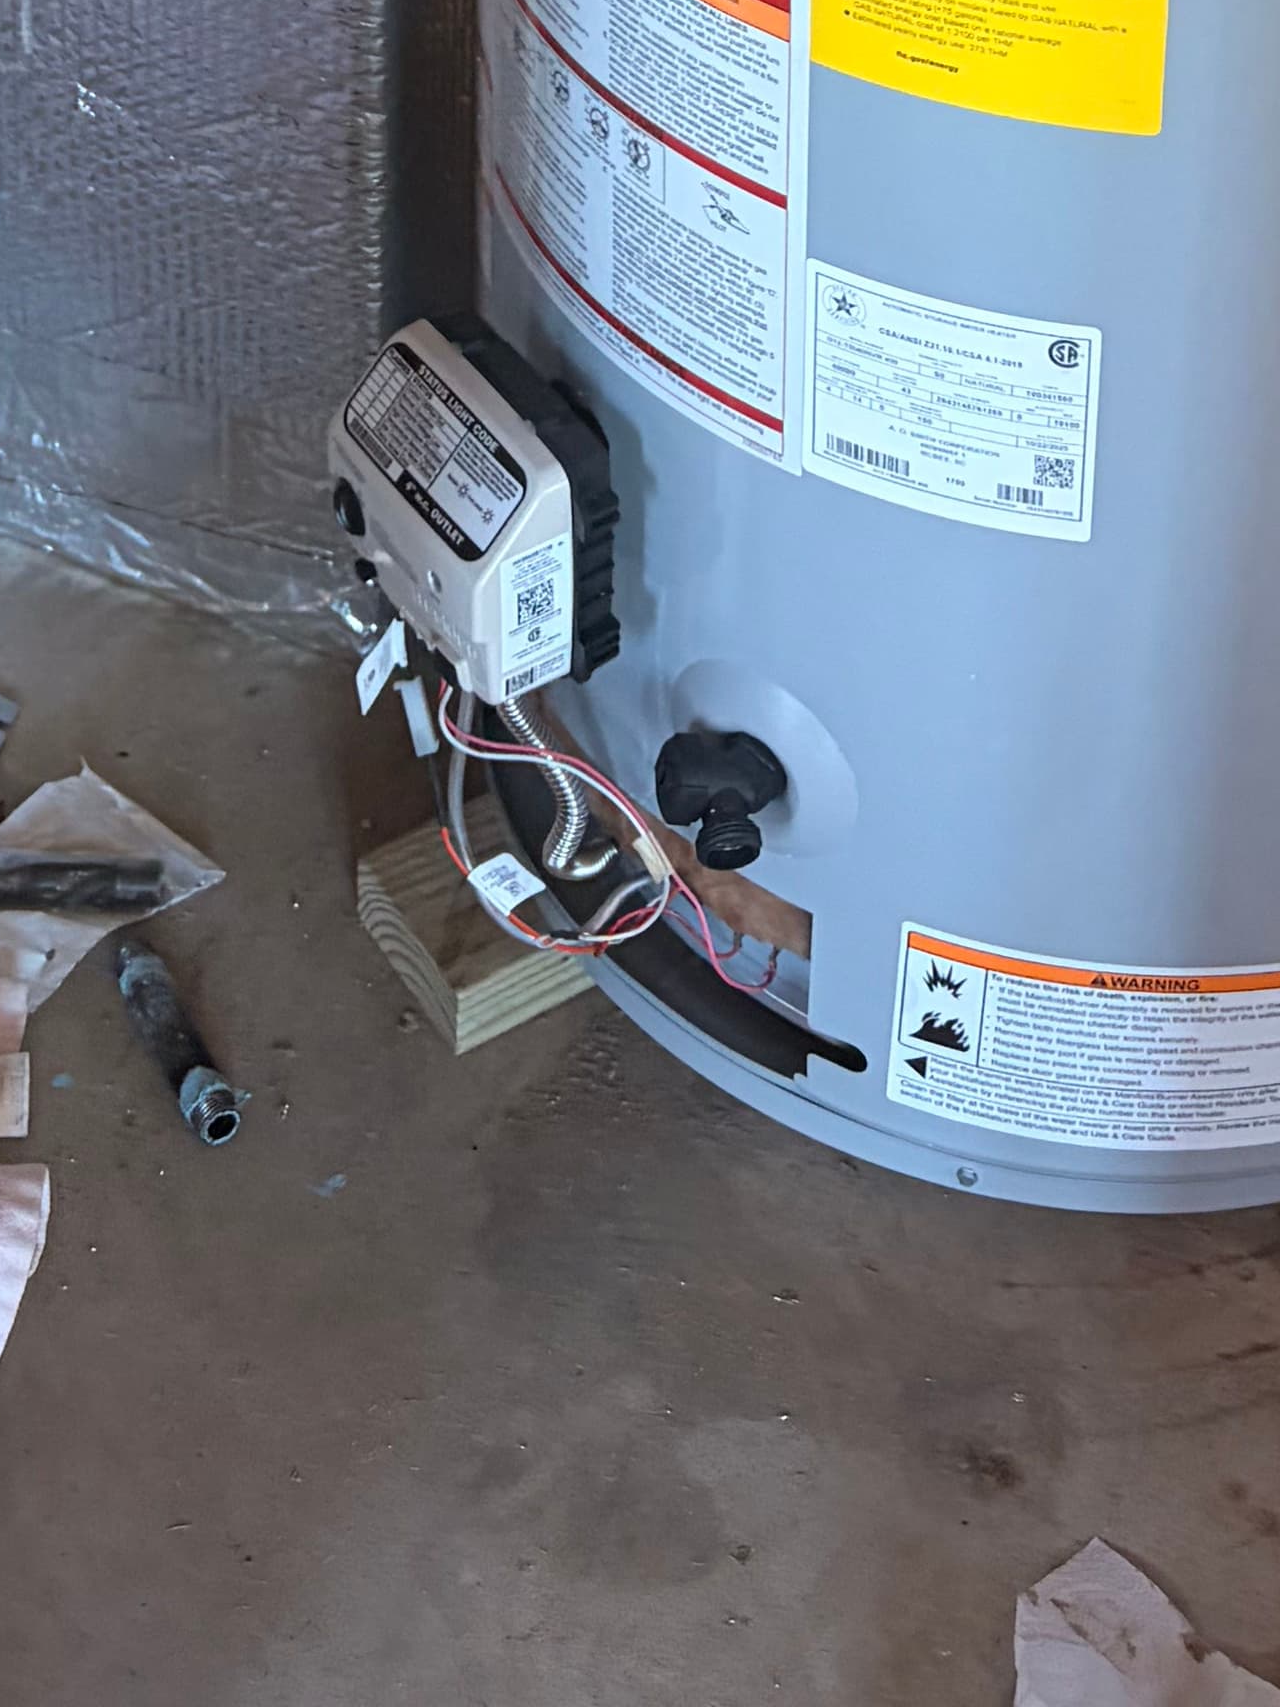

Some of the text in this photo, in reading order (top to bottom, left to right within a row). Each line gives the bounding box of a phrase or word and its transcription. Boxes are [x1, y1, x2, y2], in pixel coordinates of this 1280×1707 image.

[418, 363, 451, 401] STATUS
[446, 395, 476, 428] LIGHT
[472, 423, 502, 454] CODE
[431, 508, 465, 546] OUTLET
[1110, 977, 1200, 991] WARNING
